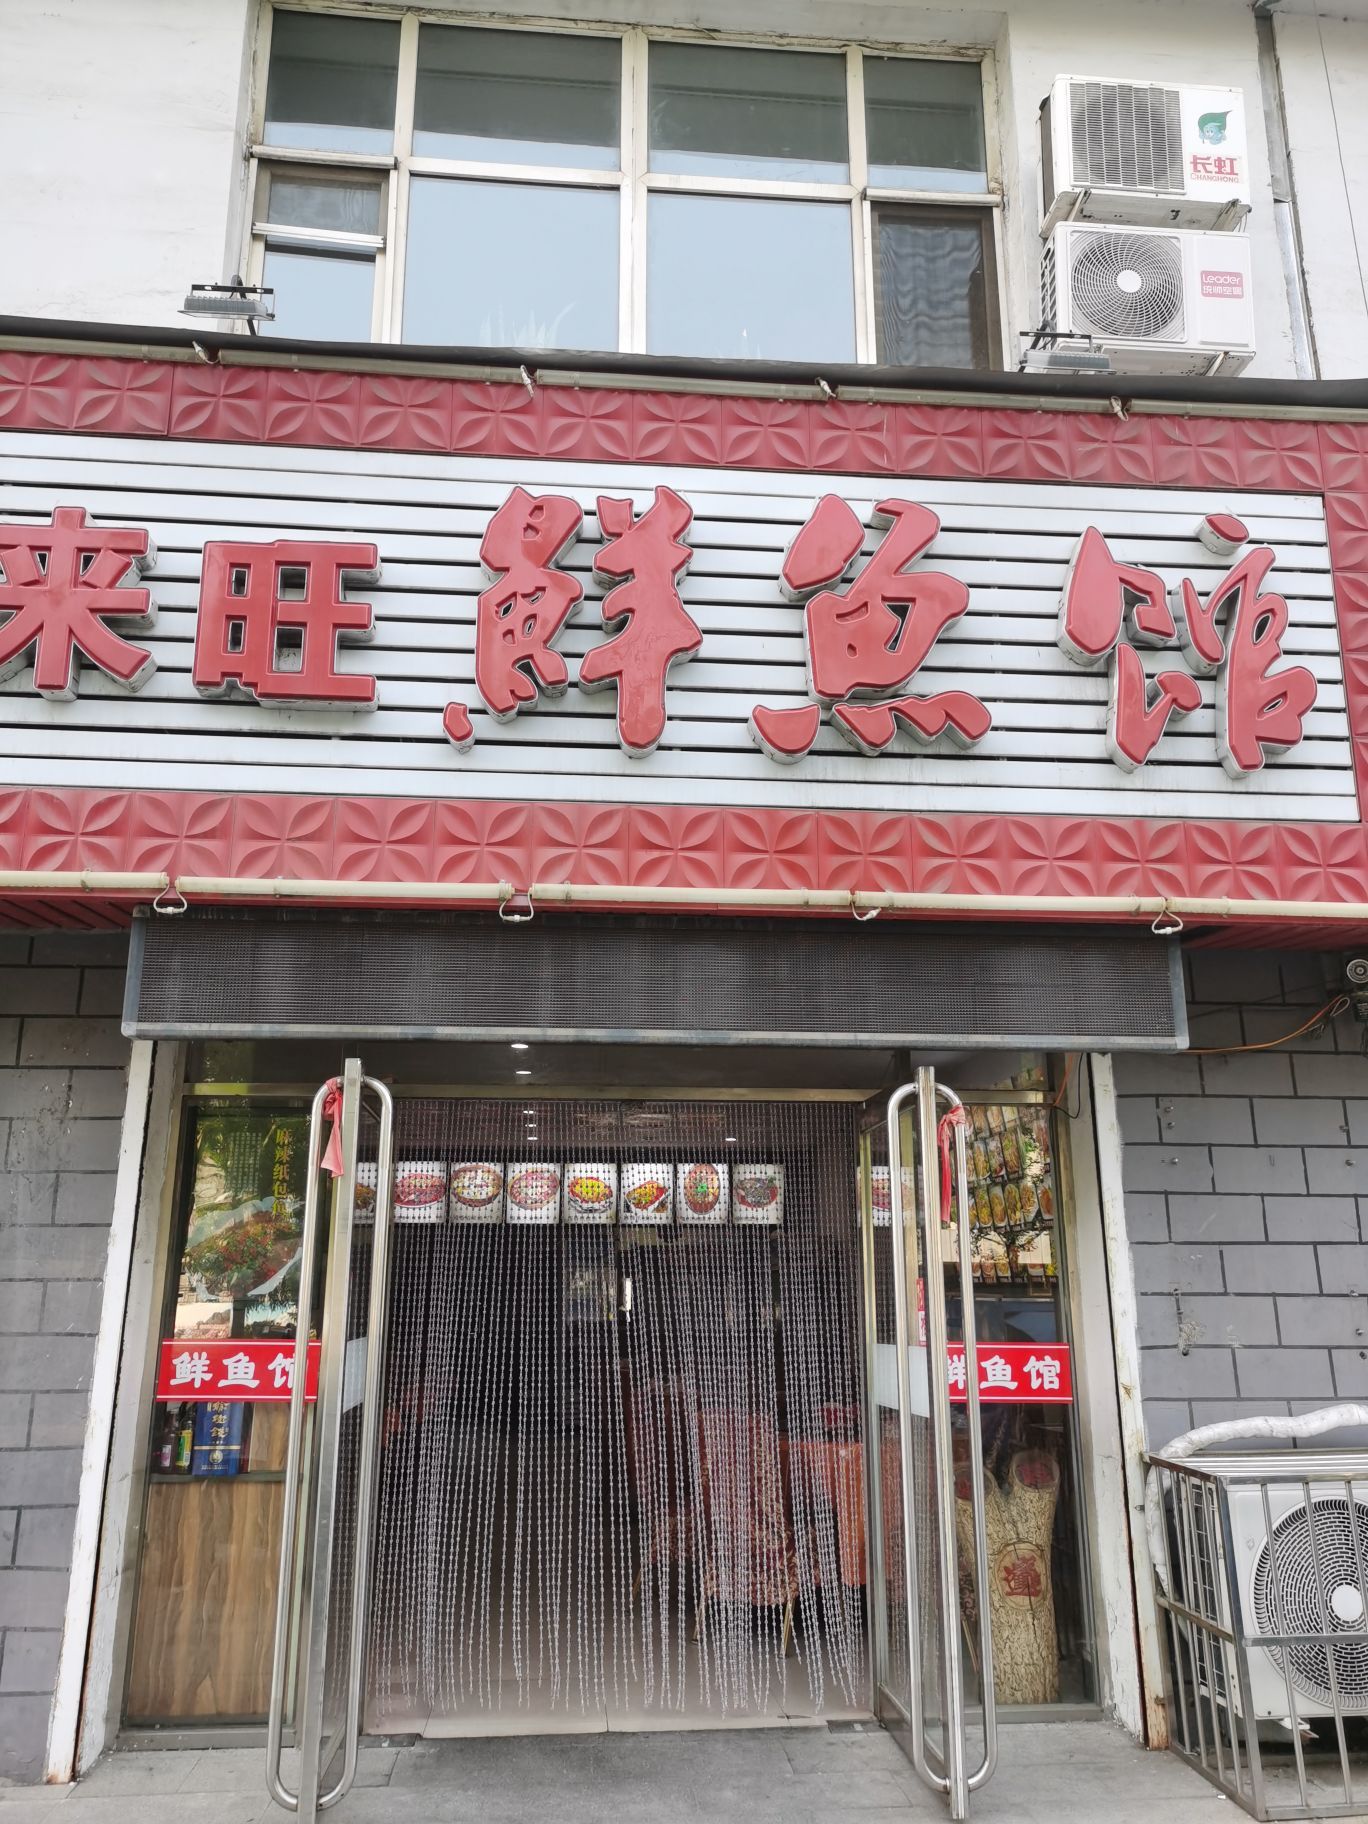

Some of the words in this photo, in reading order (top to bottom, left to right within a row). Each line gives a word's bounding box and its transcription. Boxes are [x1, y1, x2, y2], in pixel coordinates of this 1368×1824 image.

[1190, 154, 1239, 176] 长虹
[1190, 173, 1240, 184] CHANGHONG
[1202, 273, 1241, 285] Leader
